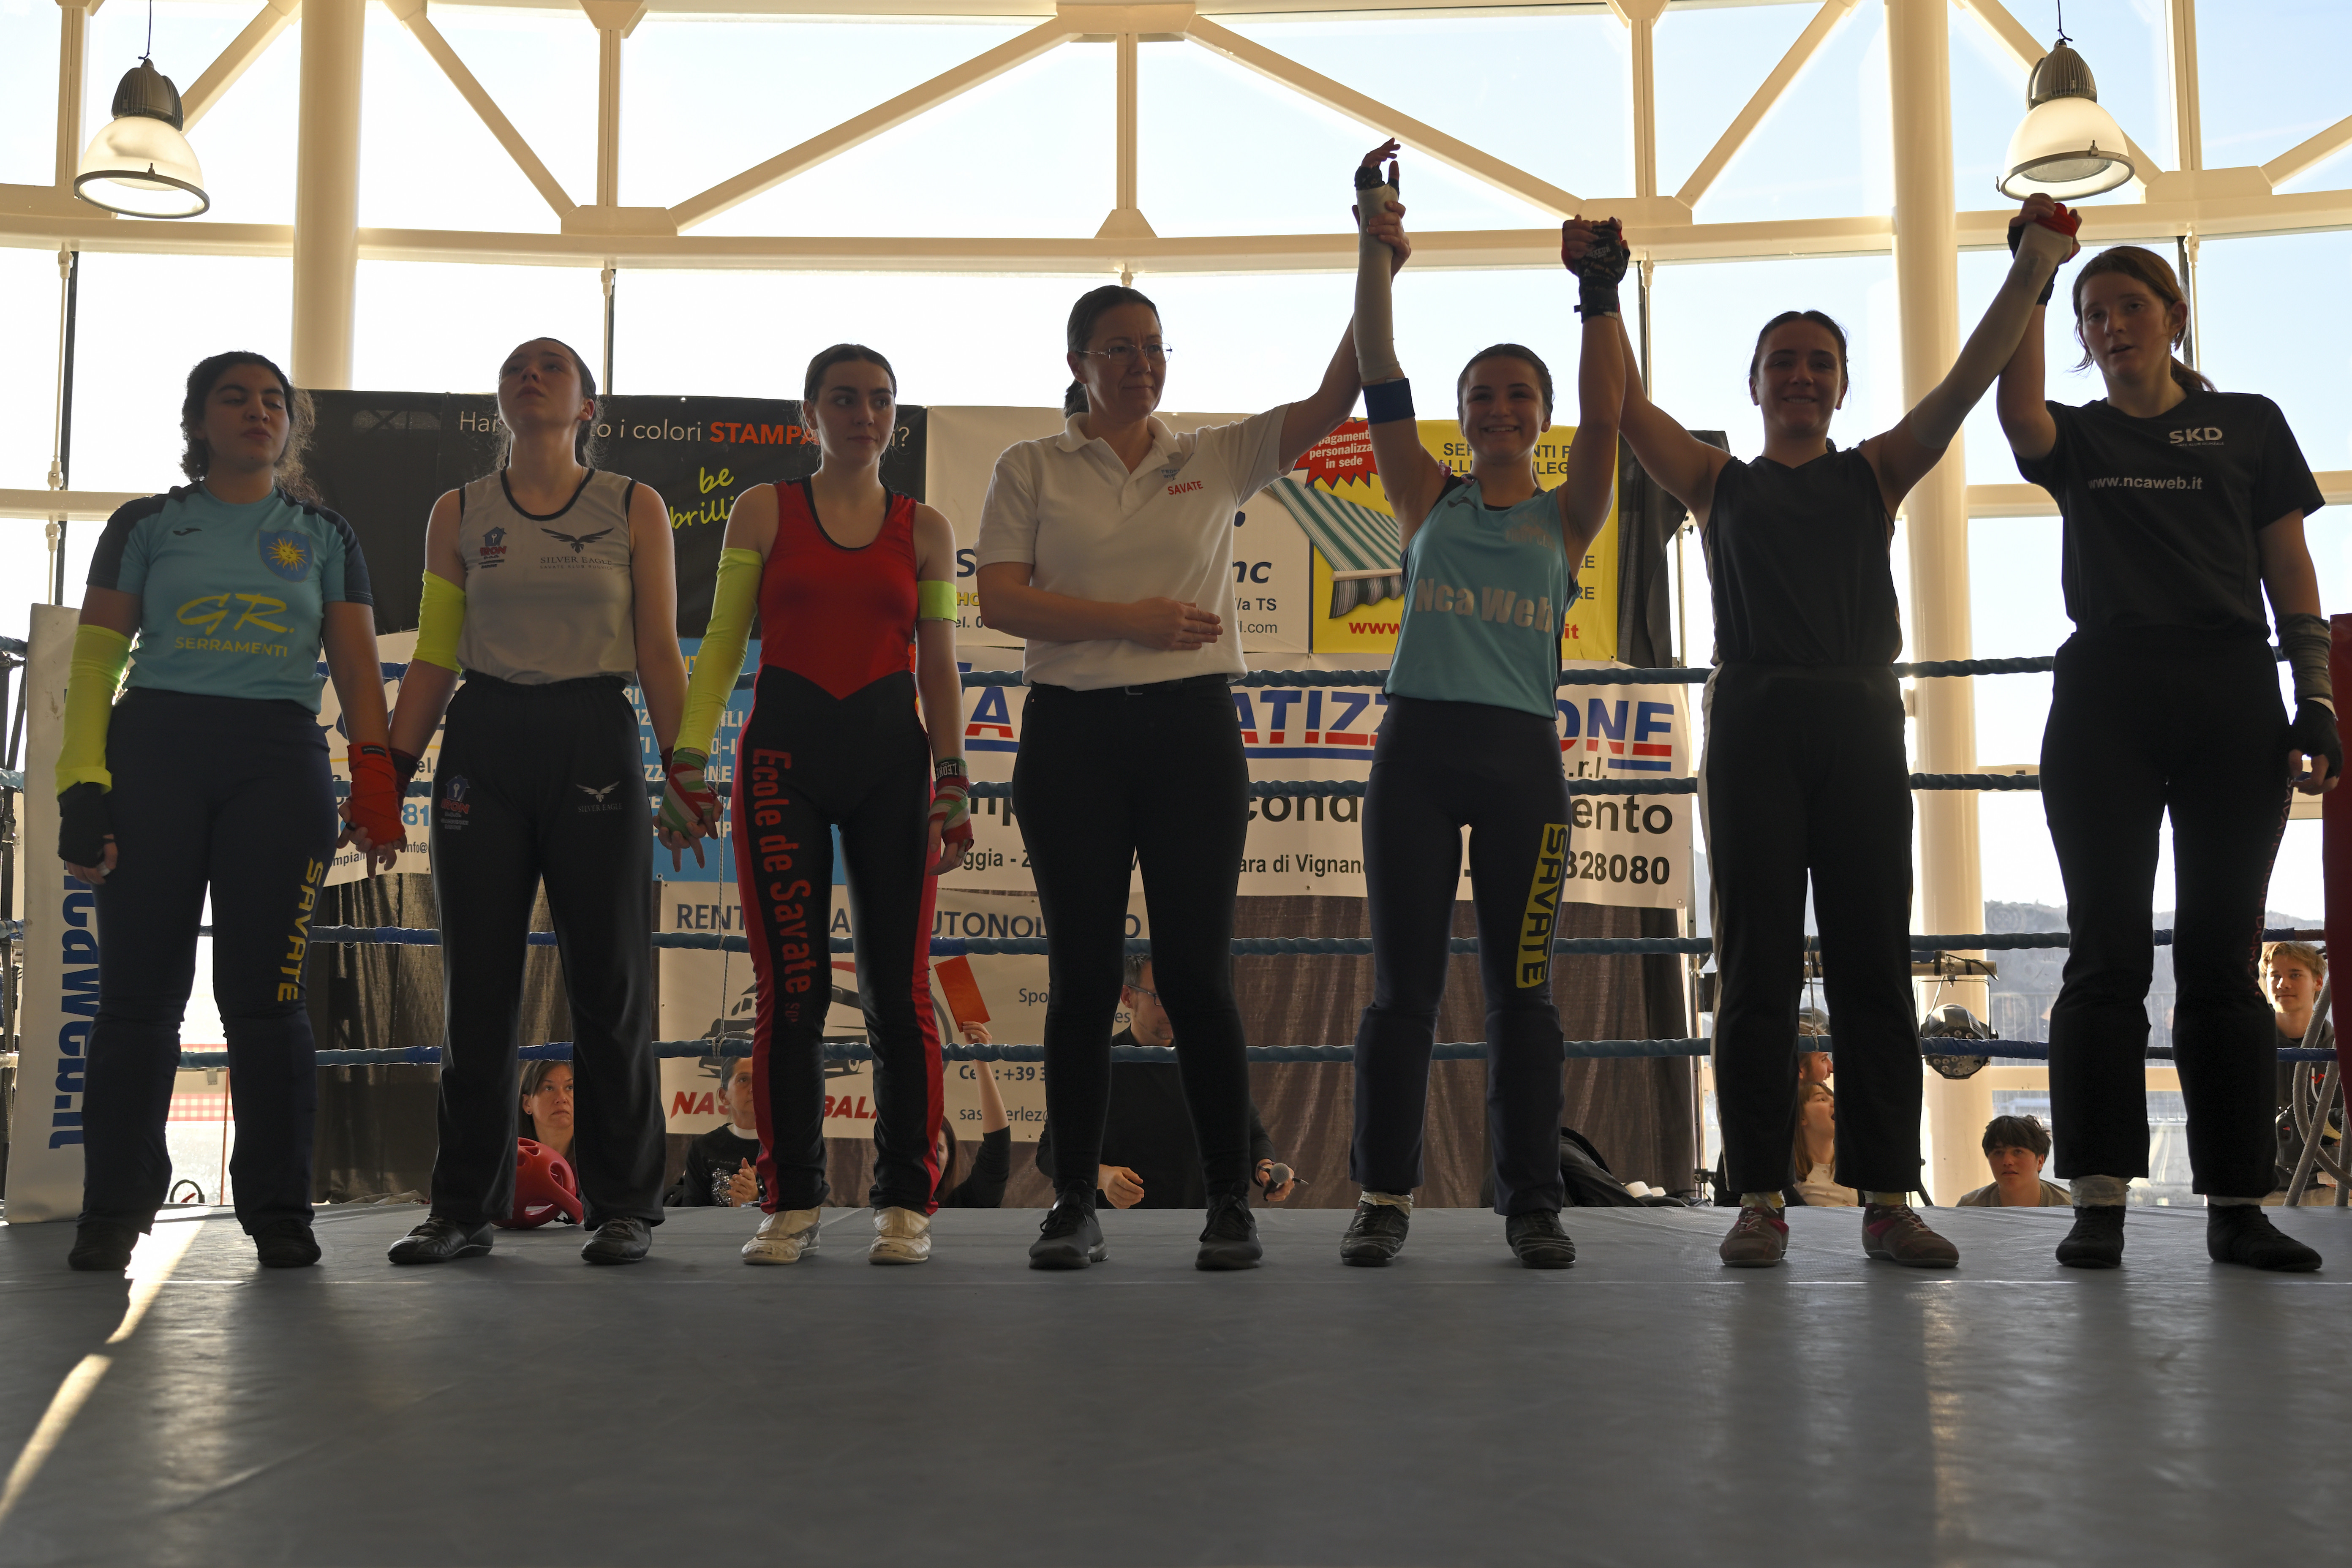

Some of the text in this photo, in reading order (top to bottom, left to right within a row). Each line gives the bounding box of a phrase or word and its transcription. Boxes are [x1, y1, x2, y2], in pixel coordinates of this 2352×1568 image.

[620, 419, 626, 438] i
[633, 419, 701, 441] colori
[2169, 427, 2223, 444] SKD
[1309, 443, 1373, 460] personalizza
[1326, 455, 1363, 469] in sede
[700, 466, 735, 494] be
[1168, 481, 1203, 495] SAVATE
[2088, 475, 2203, 490] www.ncaweb.it
[670, 495, 735, 529] brilli
[480, 546, 507, 556] IRON
[582, 557, 612, 565] EAGLE
[1255, 598, 1277, 611] TS
[1415, 578, 1553, 633] Nca Web
[1348, 623, 1400, 635] www
[174, 637, 288, 658] SERRAMENTI
[936, 763, 958, 781] LEONE
[752, 748, 792, 828] Ecole
[440, 798, 470, 814] IRON
[602, 803, 623, 811] EAGLE
[1571, 796, 1672, 834] ento
[760, 834, 799, 873] de
[1273, 855, 1290, 873] di
[1522, 826, 1568, 983] SAVATE
[277, 858, 323, 1002] SAVATE
[770, 879, 816, 994] Savate
[1004, 1066, 1035, 1081] +39
